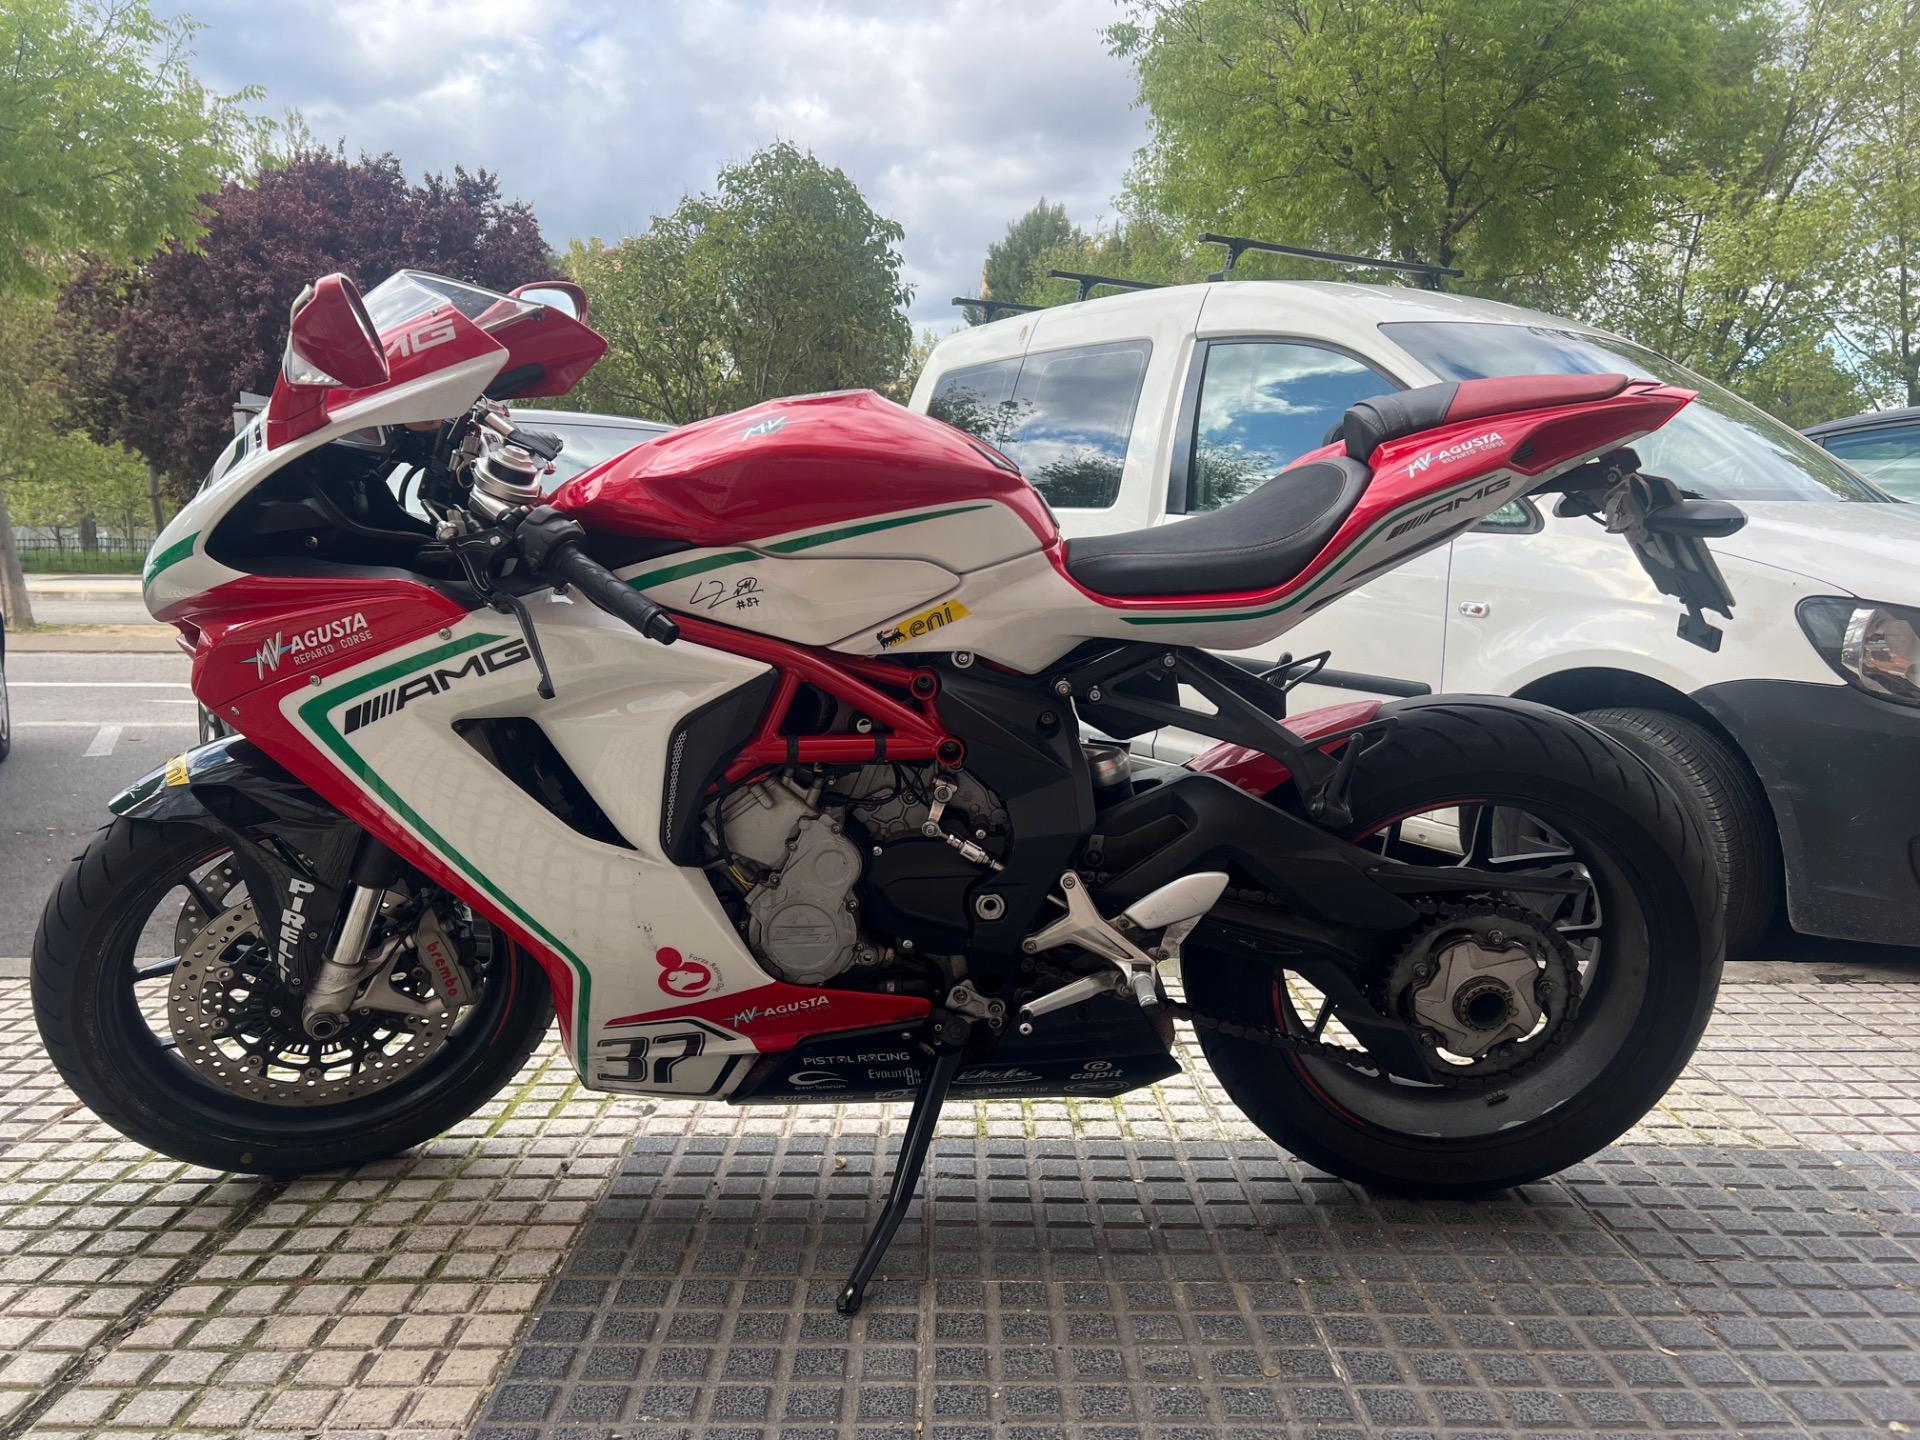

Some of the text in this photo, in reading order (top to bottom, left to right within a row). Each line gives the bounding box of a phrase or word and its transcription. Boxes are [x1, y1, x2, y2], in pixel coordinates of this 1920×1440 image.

[1438, 432, 1502, 460] AGUSTA
[1424, 476, 1511, 523] AMG
[910, 602, 953, 637] eni
[256, 612, 369, 680] MV AGUSTA
[293, 632, 373, 666] REPARTO CORSE
[396, 638, 531, 711] AMG
[427, 941, 458, 996] brembo
[734, 1006, 757, 1028] MV
[764, 995, 829, 1017] AGUSTA
[597, 1032, 705, 1083] 37
[1070, 1068, 1124, 1080] capit
